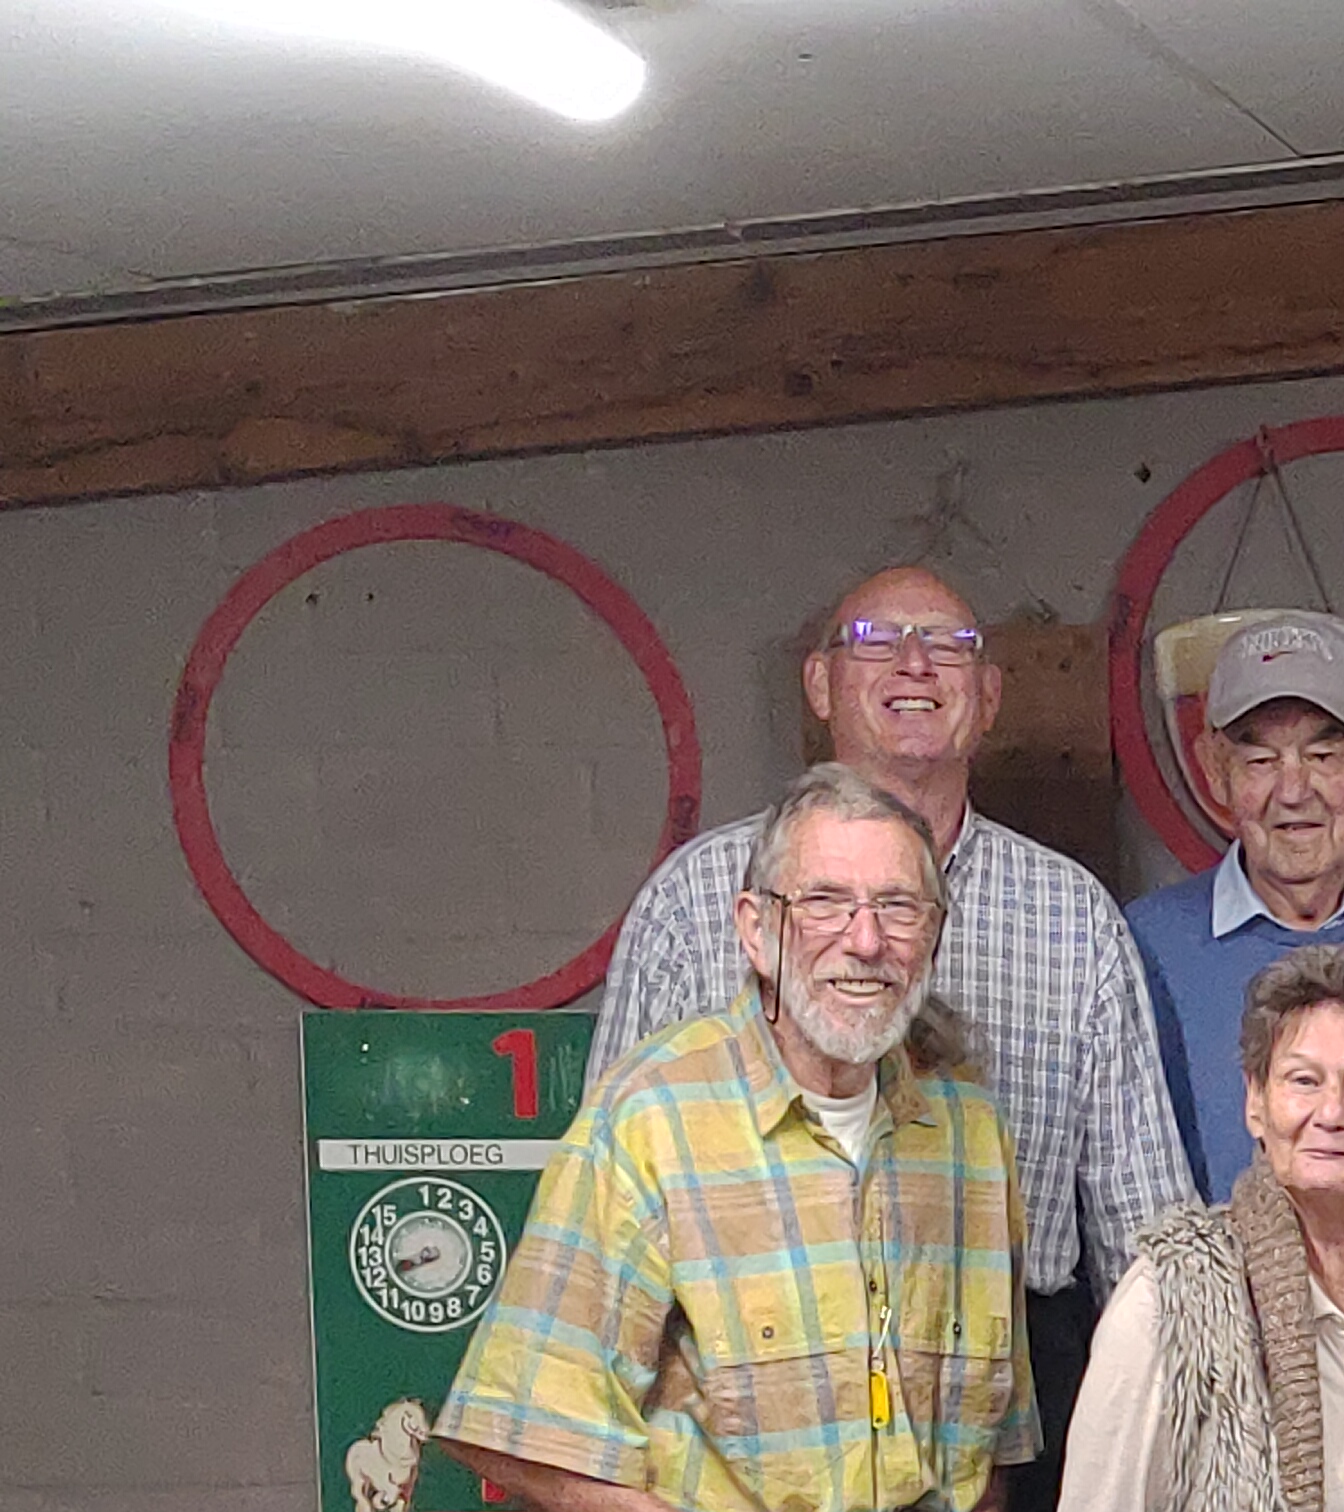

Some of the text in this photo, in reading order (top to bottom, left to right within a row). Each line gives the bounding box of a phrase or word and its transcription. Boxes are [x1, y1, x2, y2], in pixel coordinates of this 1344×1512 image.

[492, 1029, 539, 1119] 1
[349, 1144, 504, 1166] THUISPLOEG
[358, 1185, 495, 1323] 1 2 3 4 5 6 7 8 9 10 11 12 13 14 15
